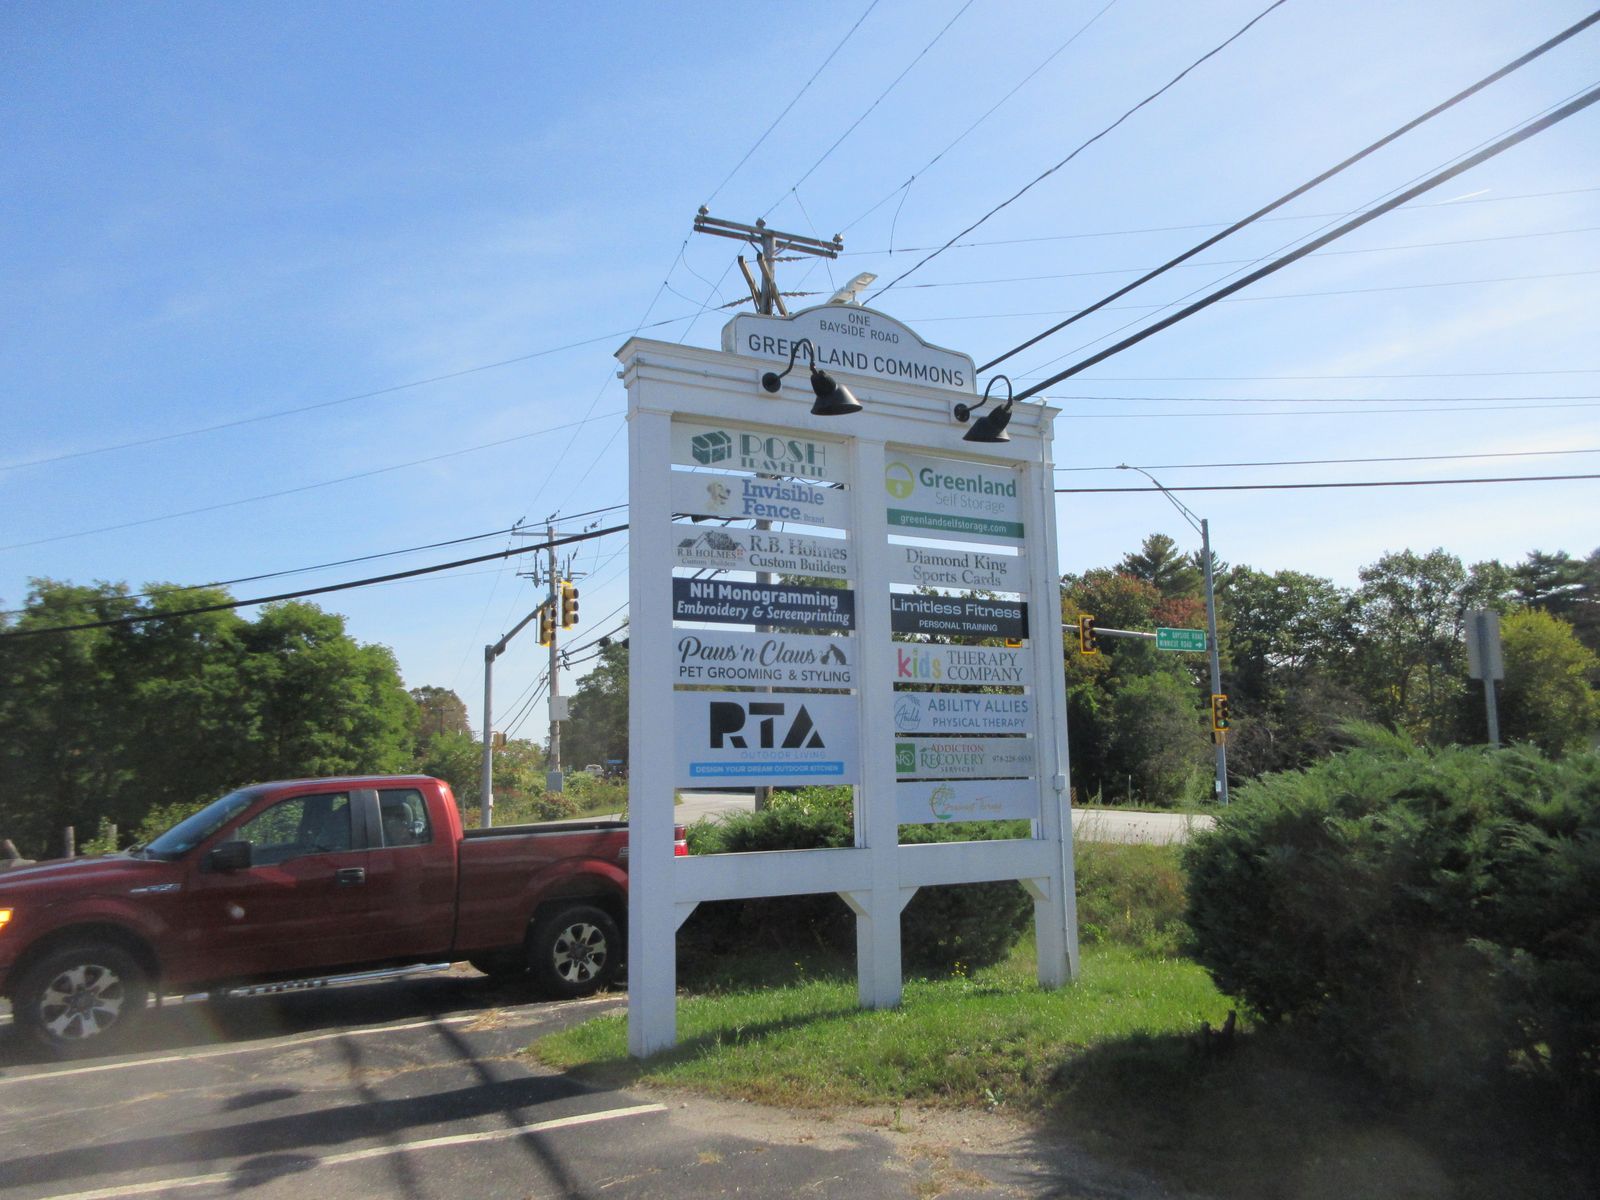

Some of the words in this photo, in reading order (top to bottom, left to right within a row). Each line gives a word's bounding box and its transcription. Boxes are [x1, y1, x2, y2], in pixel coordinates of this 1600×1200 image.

[848, 313, 871, 326] ONE
[820, 319, 866, 338] BAYSIDE
[870, 330, 899, 344] ROAD
[748, 334, 868, 370] GREENLAND
[873, 356, 964, 387] COMMONS
[740, 434, 826, 466] POSH
[741, 479, 825, 505] Invisible
[919, 467, 1017, 498] Greenland
[741, 497, 800, 520] Fence
[935, 492, 958, 506] Self
[960, 495, 1005, 514] Storage
[900, 515, 1007, 533] greenlandselfstorage.com
[695, 549, 737, 560] HOLMES
[750, 534, 784, 554] R.B.
[789, 537, 847, 560] Holmes
[750, 554, 797, 570] Custom
[800, 559, 847, 574] Builders
[906, 548, 969, 568] Diamond
[974, 554, 1007, 574] King
[912, 565, 957, 584] Sports
[961, 569, 1001, 586] Cards
[690, 582, 714, 598] NH
[719, 584, 839, 610] Monogramming
[676, 601, 749, 619] Embroidery
[752, 606, 764, 618] &
[767, 606, 850, 625] Screenprinting
[892, 599, 962, 616] Limitless
[965, 603, 1021, 619] Fitness
[919, 619, 960, 630] PERSONAL
[961, 622, 998, 632] TRAINING
[678, 635, 738, 663] Paws
[759, 639, 818, 667] Claws
[946, 650, 1018, 666] THERAPY
[897, 648, 942, 679] kids
[947, 665, 1024, 681] COMPANY
[679, 666, 703, 678] PET
[707, 667, 782, 680] GROOMING
[788, 670, 798, 681] &
[801, 670, 851, 683] STYLING
[928, 699, 980, 712] ABILITY
[984, 700, 1029, 713] ALLIES
[709, 701, 826, 749] RTA
[932, 717, 980, 728] PHYSICAL
[983, 717, 1025, 728] THERAPY
[794, 751, 826, 759] LIVING
[931, 743, 984, 753] ADDICTION
[725, 765, 747, 773] YOUR
[774, 764, 809, 772] OUTDOOR
[920, 752, 986, 769] RECOVERY
